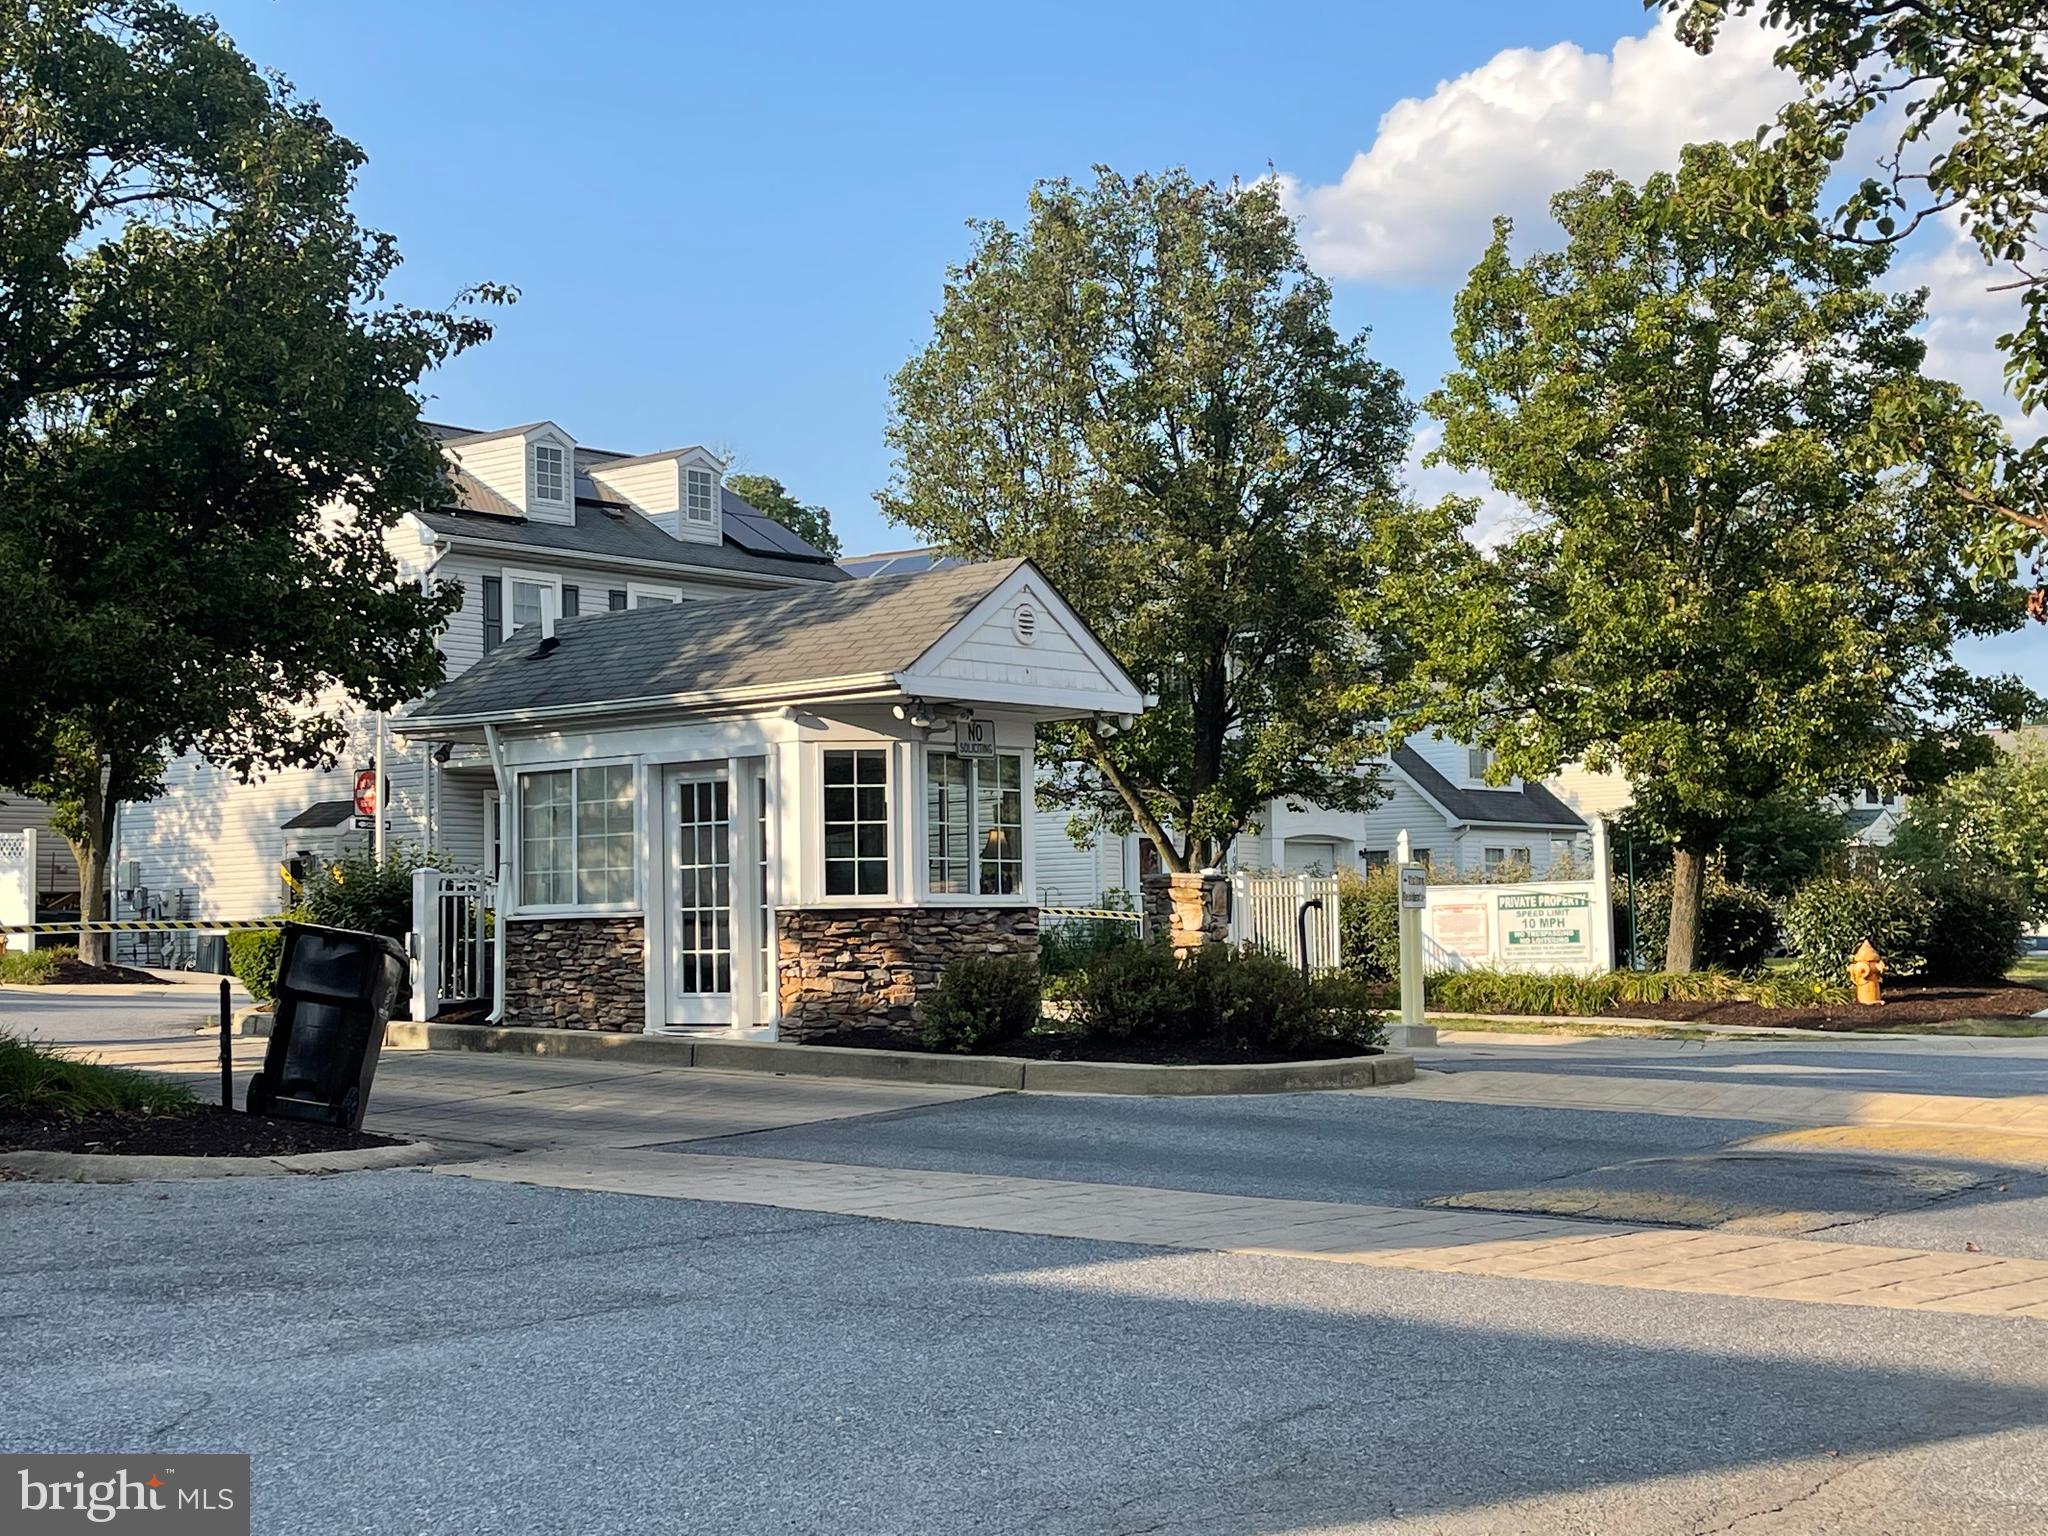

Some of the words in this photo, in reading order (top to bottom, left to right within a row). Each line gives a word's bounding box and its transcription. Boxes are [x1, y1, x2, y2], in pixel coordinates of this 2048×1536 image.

[968, 723, 983, 741] NO
[959, 742, 993, 754] SOLICITING
[1499, 895, 1537, 908] PRIVATE
[1538, 894, 1586, 907] PROPERTY
[1516, 909, 1544, 918] SPEED
[1546, 908, 1570, 917] LIMIT
[1521, 918, 1536, 929] 10
[1540, 917, 1565, 928] MPH
